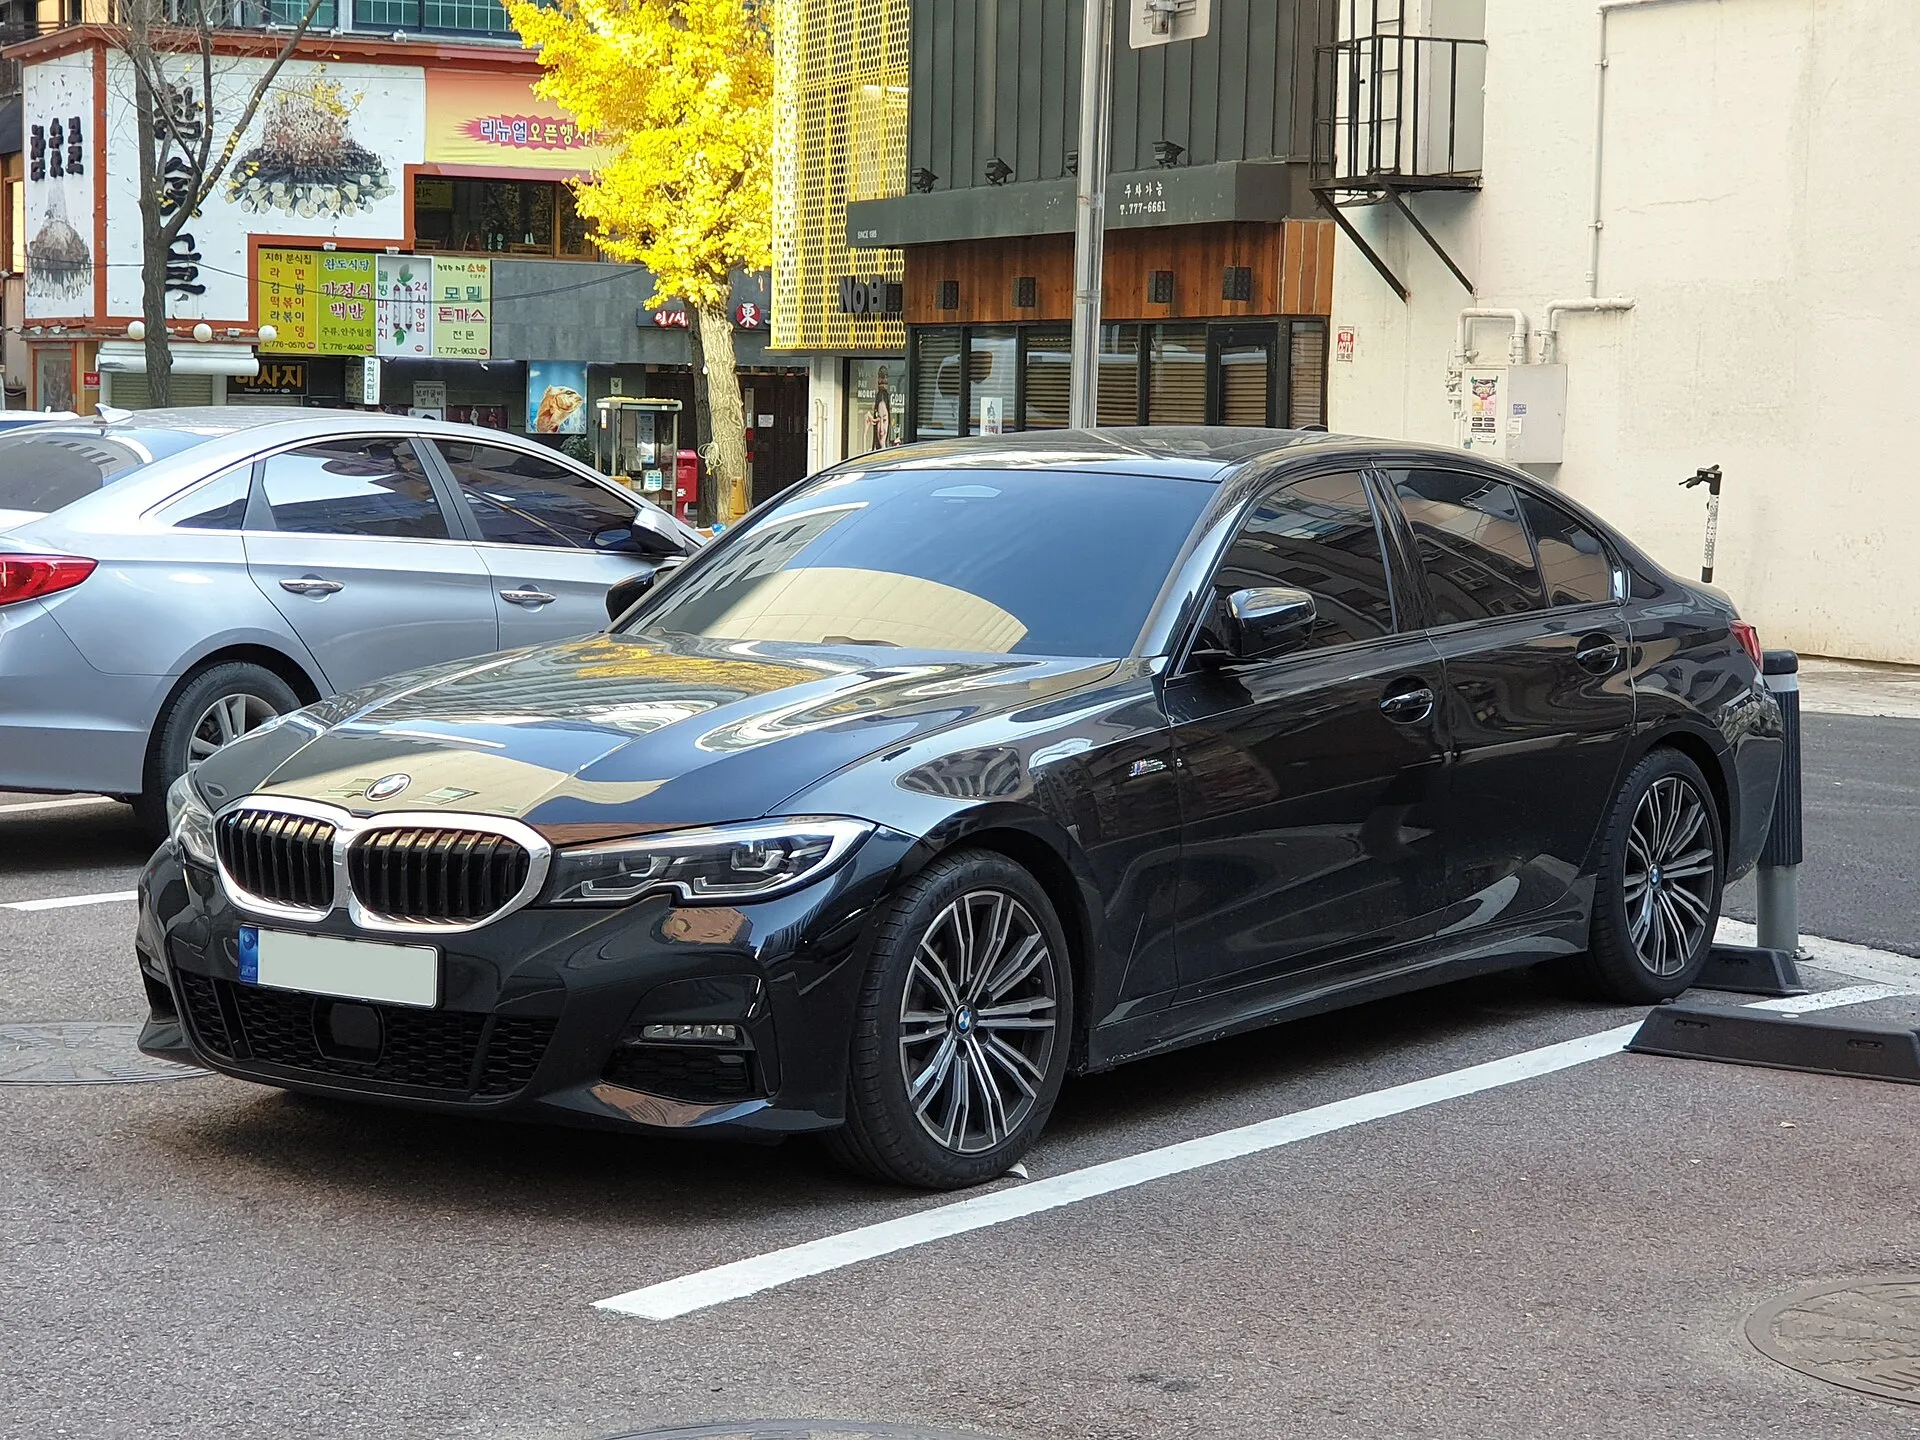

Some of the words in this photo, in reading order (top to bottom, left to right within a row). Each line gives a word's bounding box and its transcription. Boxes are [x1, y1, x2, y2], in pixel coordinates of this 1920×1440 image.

[1124, 181, 1163, 199] 주차가능
[1120, 200, 1166, 215] T.777-6661
[265, 253, 283, 262] 지하
[286, 254, 312, 265] 분식집
[324, 258, 370, 271] 완도식당
[269, 267, 304, 280] 라면
[467, 263, 487, 272] 소바
[270, 282, 304, 295] 김밥
[321, 281, 372, 301] 가정식
[444, 286, 482, 302] 모밀
[270, 297, 304, 309] 떡볶이
[270, 311, 304, 323] 라볶이
[330, 302, 365, 320] 백반
[438, 306, 486, 323] 돈까스
[740, 302, 758, 328] 東
[452, 331, 475, 340] 전문
[329, 343, 364, 351] 776-4040
